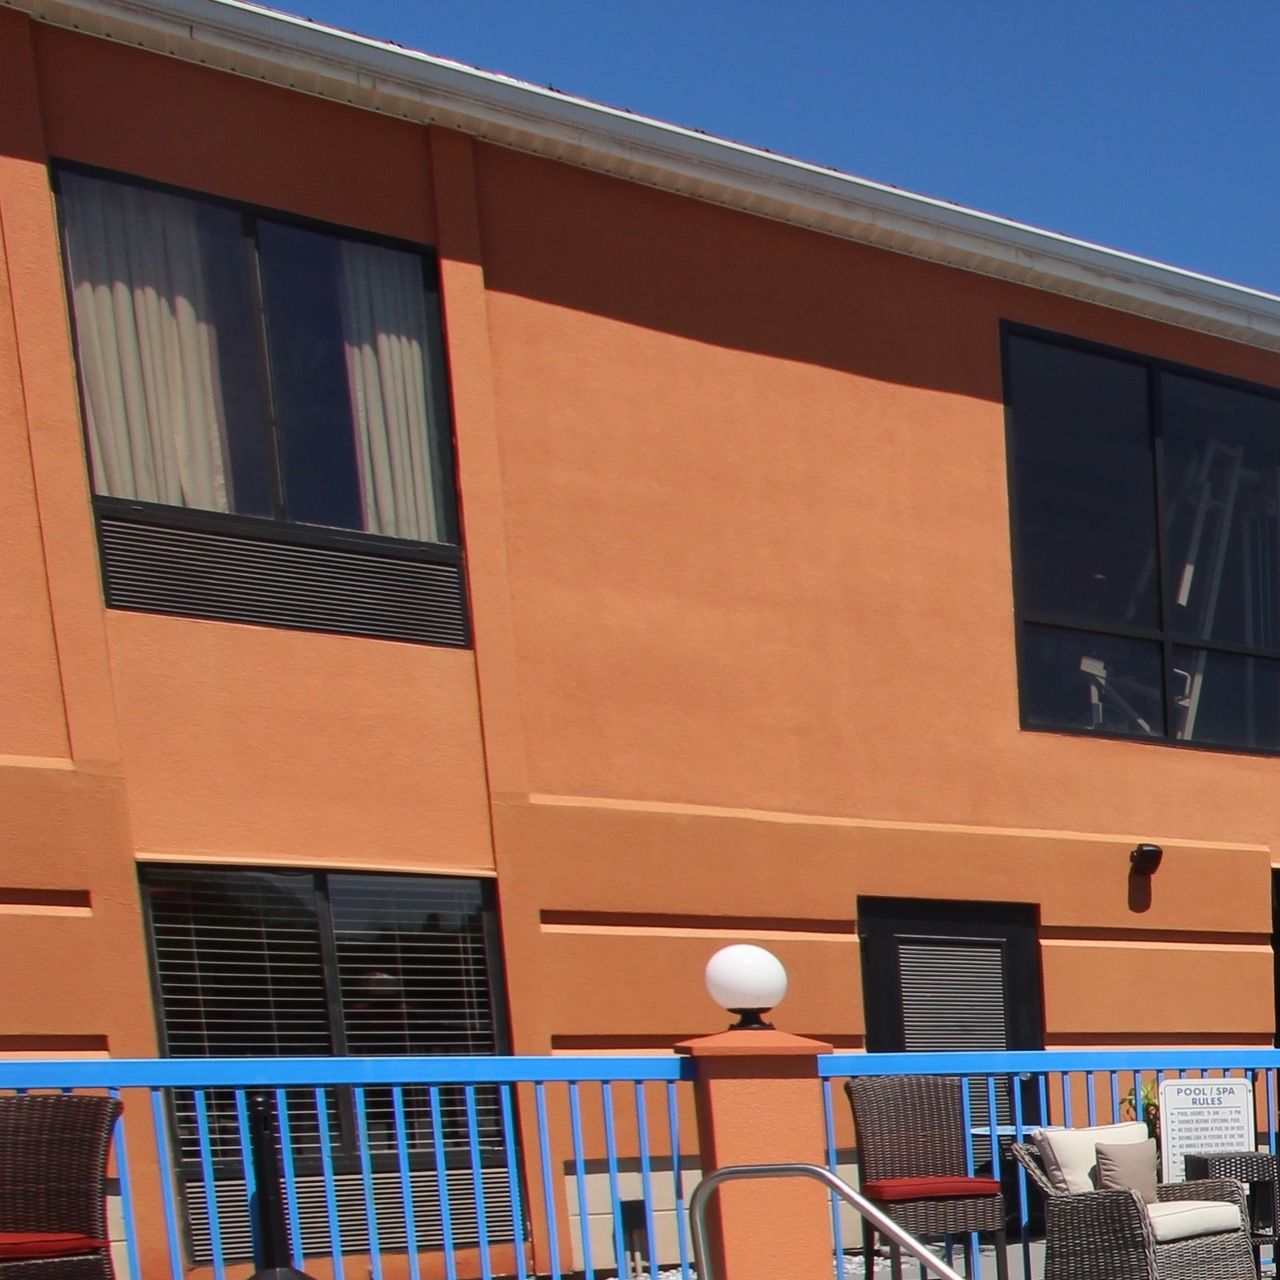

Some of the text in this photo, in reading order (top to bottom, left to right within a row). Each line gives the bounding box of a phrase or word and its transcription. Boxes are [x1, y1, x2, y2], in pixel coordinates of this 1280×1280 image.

[1177, 1087, 1207, 1096] POOL
[1216, 1087, 1235, 1095] SPA
[1192, 1097, 1223, 1106] RULES
